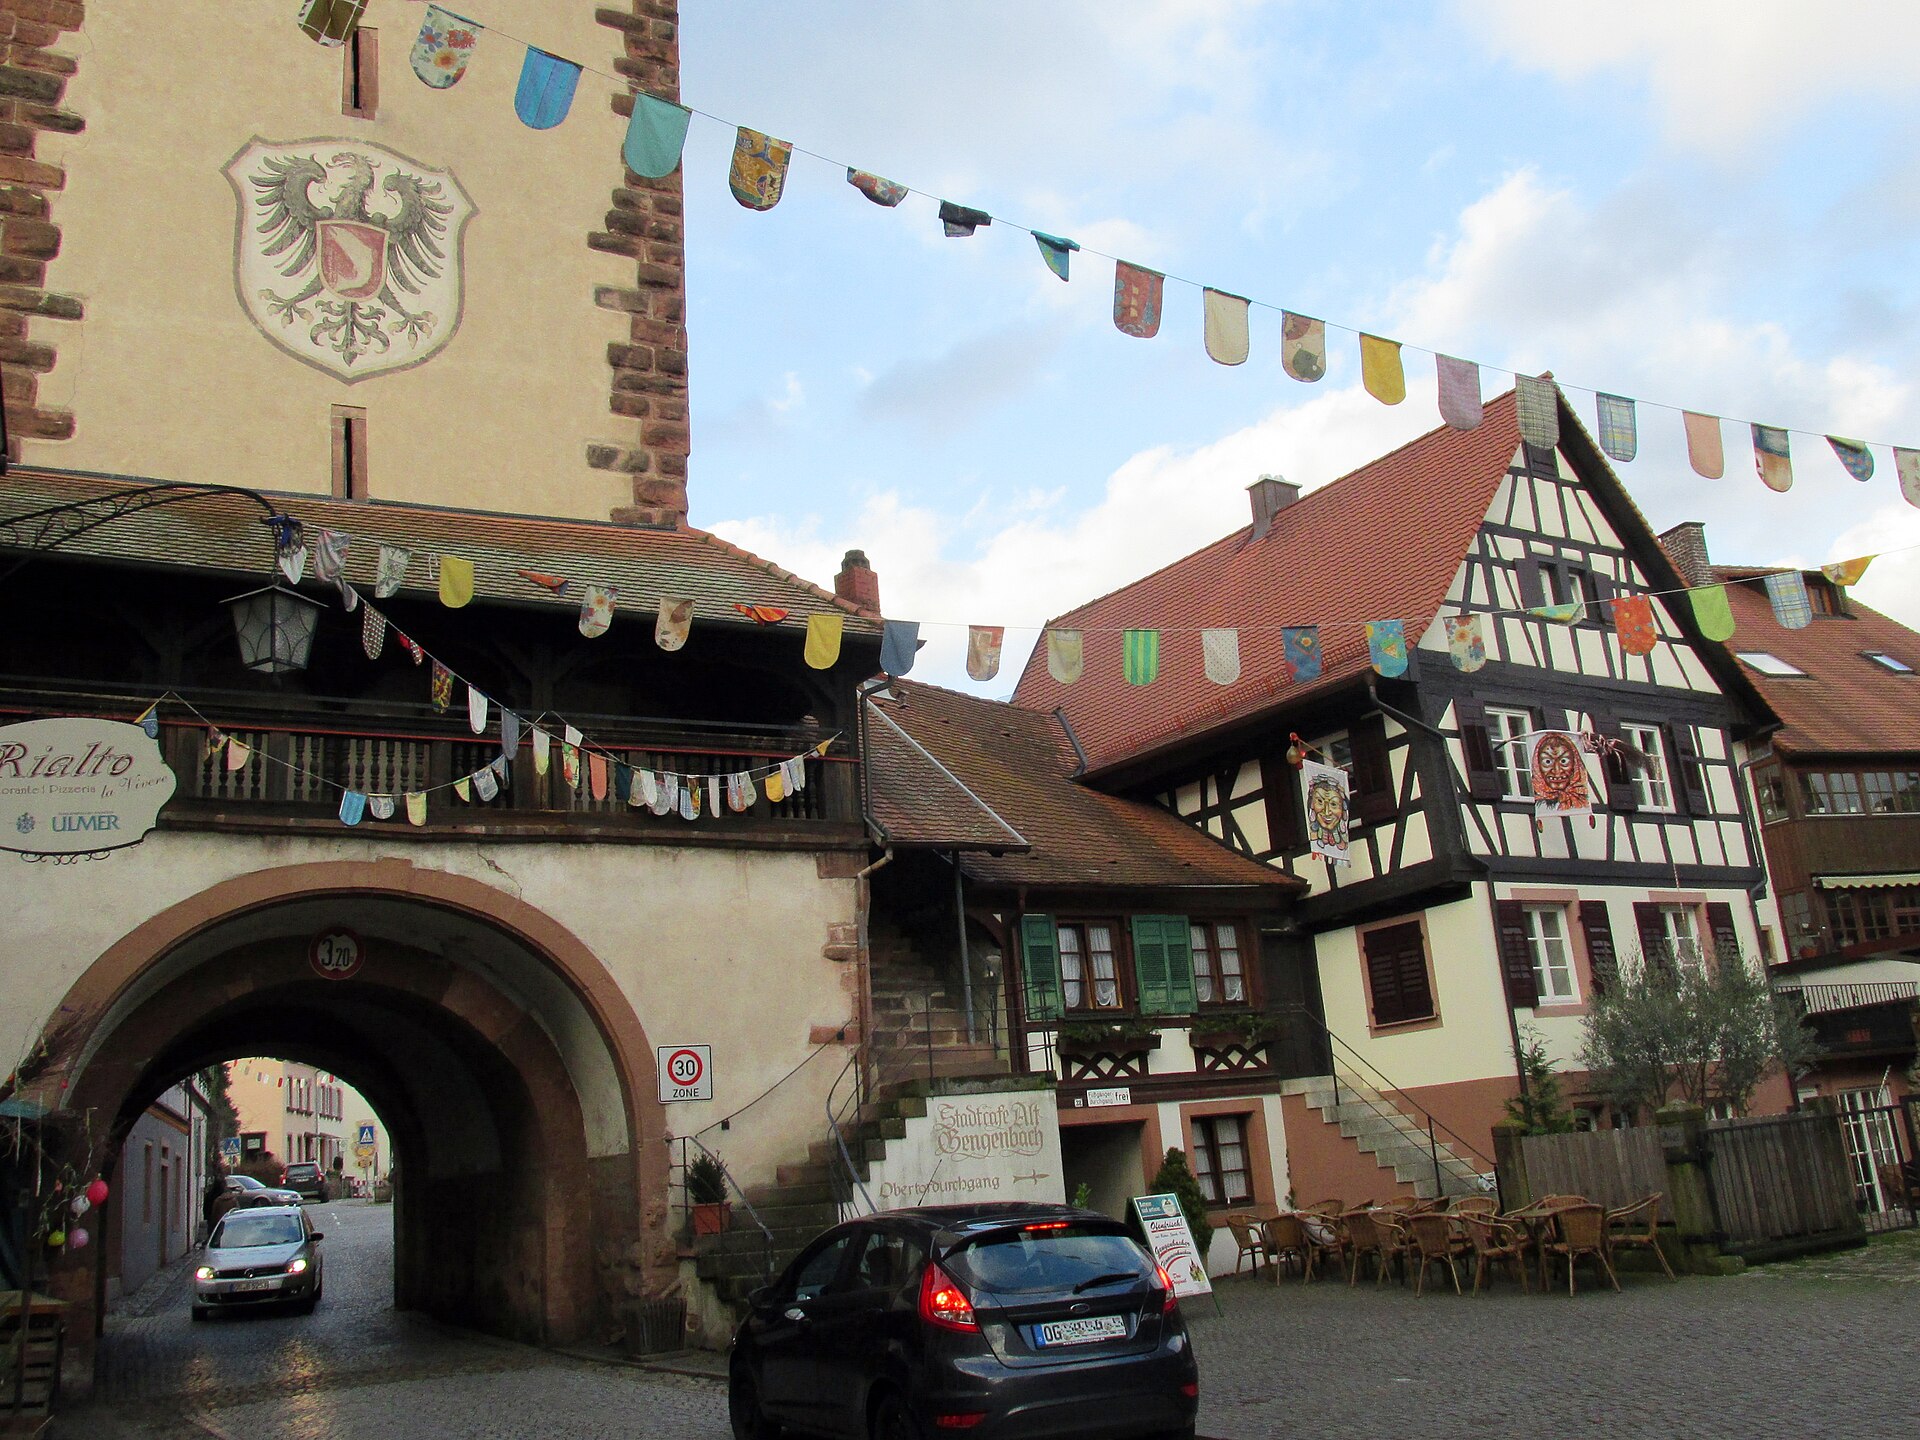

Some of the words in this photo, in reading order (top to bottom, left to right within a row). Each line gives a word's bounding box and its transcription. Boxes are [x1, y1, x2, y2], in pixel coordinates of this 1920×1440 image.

[0, 741, 134, 778] Rialto
[49, 784, 96, 794] Pizzeria
[52, 814, 120, 832] ULMER
[674, 1059, 696, 1077] 30
[672, 1087, 700, 1098] ZONE
[1115, 1091, 1129, 1101] frei
[1011, 1101, 1041, 1127] Alt
[936, 1124, 1044, 1161] Gengenbach
[879, 1175, 1001, 1198] Obertordurchgang
